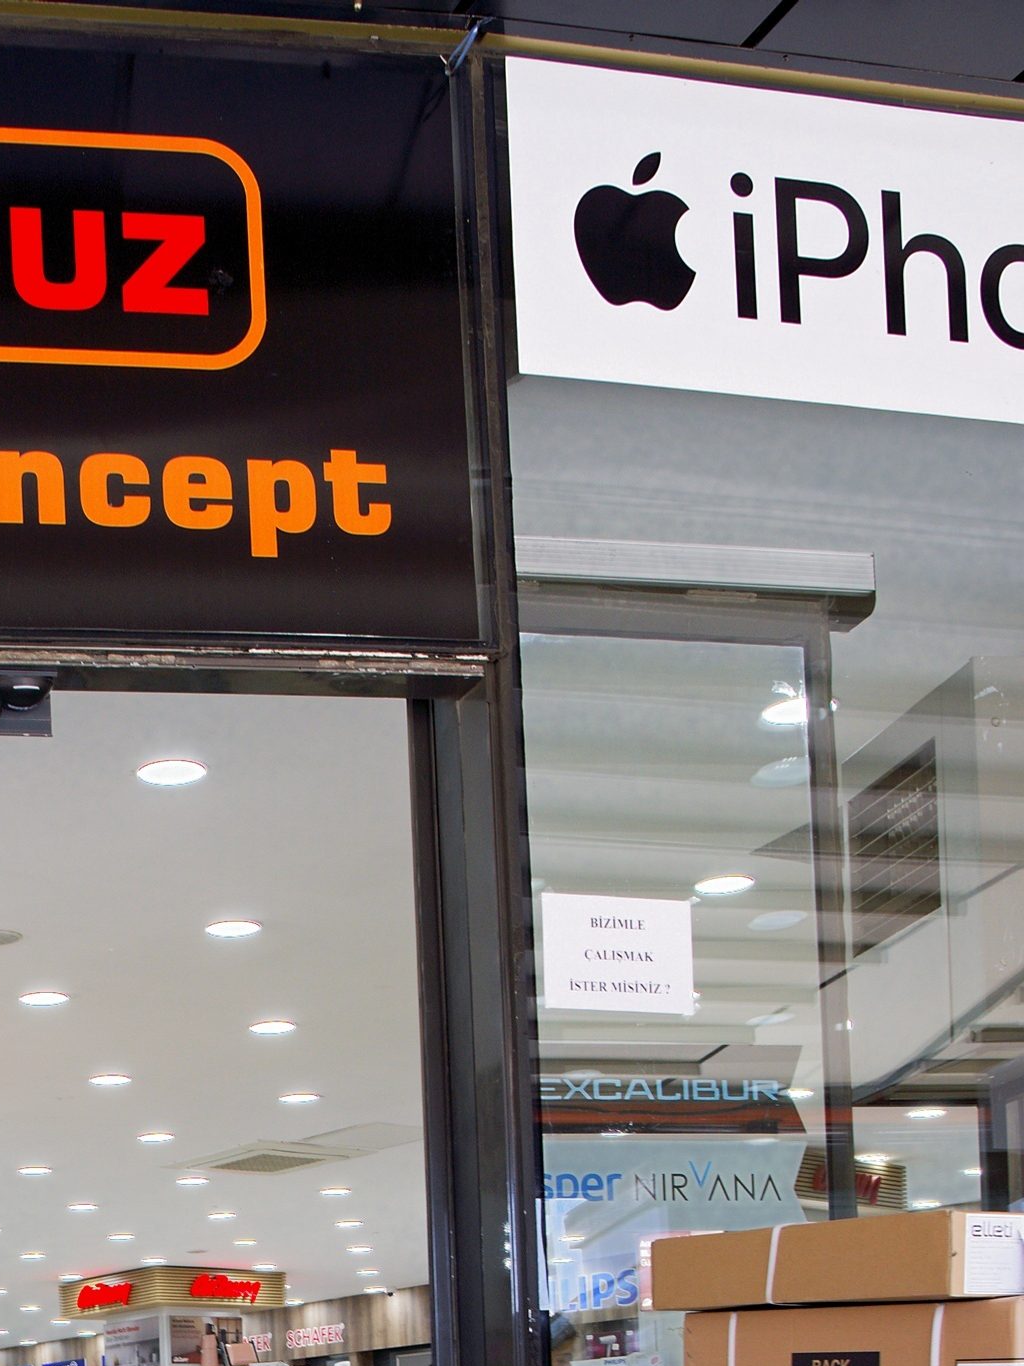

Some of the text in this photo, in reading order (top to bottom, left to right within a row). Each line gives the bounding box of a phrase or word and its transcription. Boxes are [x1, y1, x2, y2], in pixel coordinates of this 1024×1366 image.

[590, 915, 646, 931] BİZİMLE
[584, 949, 654, 963] ÇALIŞMAK
[570, 978, 608, 993] İSTER
[611, 979, 662, 995] MİSİNİZ
[540, 1078, 779, 1101] EXCALIBUR
[635, 1161, 782, 1202] NIRVANA
[285, 1324, 344, 1350] SCHAFER
